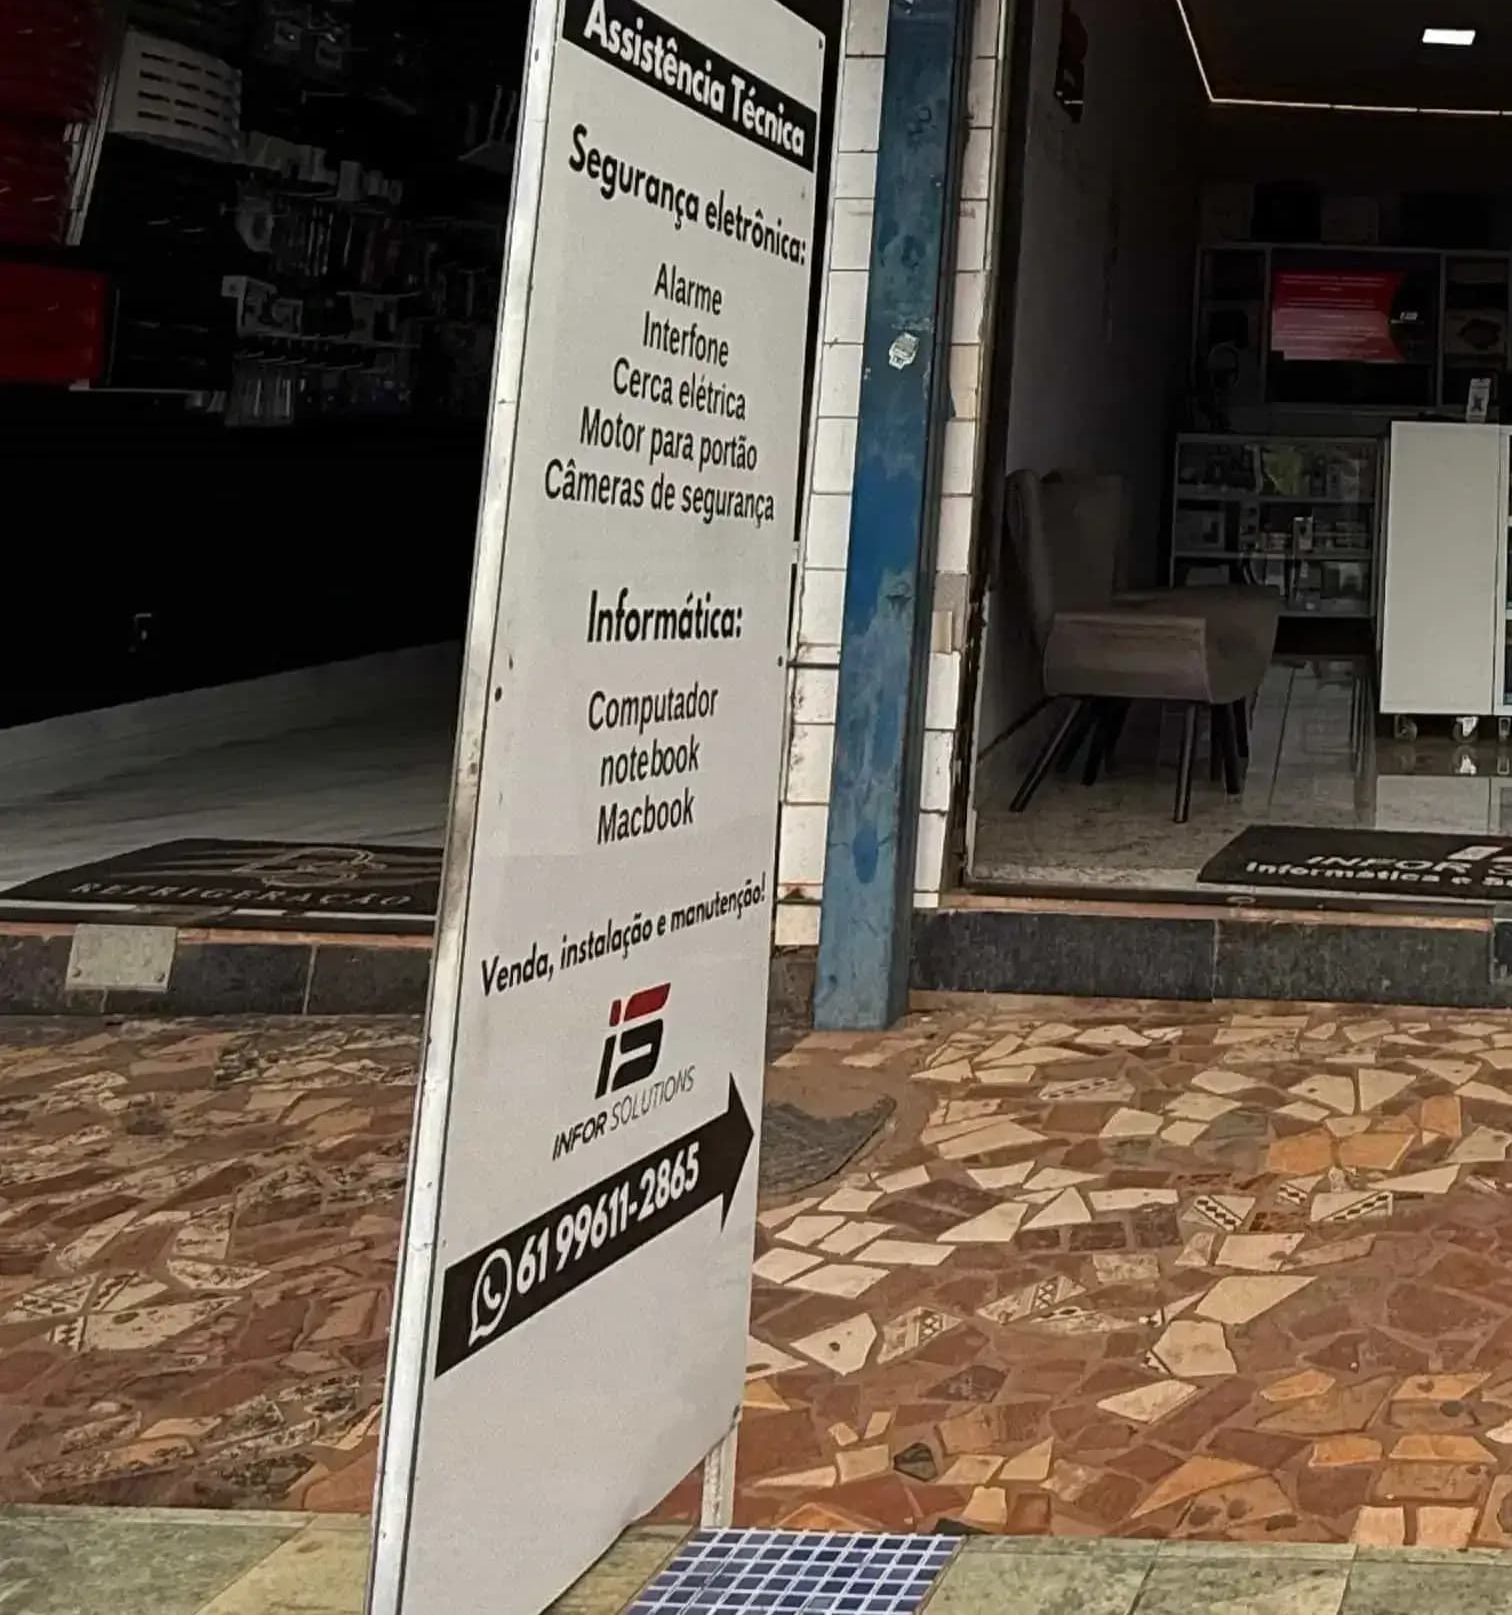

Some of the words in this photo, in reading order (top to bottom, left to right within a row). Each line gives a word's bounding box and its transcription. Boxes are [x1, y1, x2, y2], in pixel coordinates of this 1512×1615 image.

[730, 73, 806, 157] Técnica
[568, 123, 699, 231] Segurança
[705, 189, 806, 265] eletrônica:
[653, 262, 723, 316] Alarme
[642, 310, 730, 367] Interfone
[613, 356, 673, 407] Cerca
[679, 372, 746, 420] elétrica
[580, 405, 645, 453] Motor
[650, 427, 694, 466] para
[699, 434, 758, 472] portão
[545, 458, 644, 508] Câmeras
[651, 472, 676, 511] de
[680, 485, 774, 529] segurança
[587, 587, 743, 643] Informática:
[588, 681, 719, 735] Computador
[600, 734, 699, 787] notebook
[597, 787, 695, 845] Macbook
[481, 943, 554, 997] Venda,
[560, 911, 653, 970] instalação
[657, 913, 667, 937] e
[670, 871, 767, 932] manutenção!
[552, 1110, 607, 1162] INFOR
[610, 1065, 696, 1132] SOLUTIONS
[515, 1231, 550, 1295] 61
[555, 1141, 700, 1274] 99611-2865
